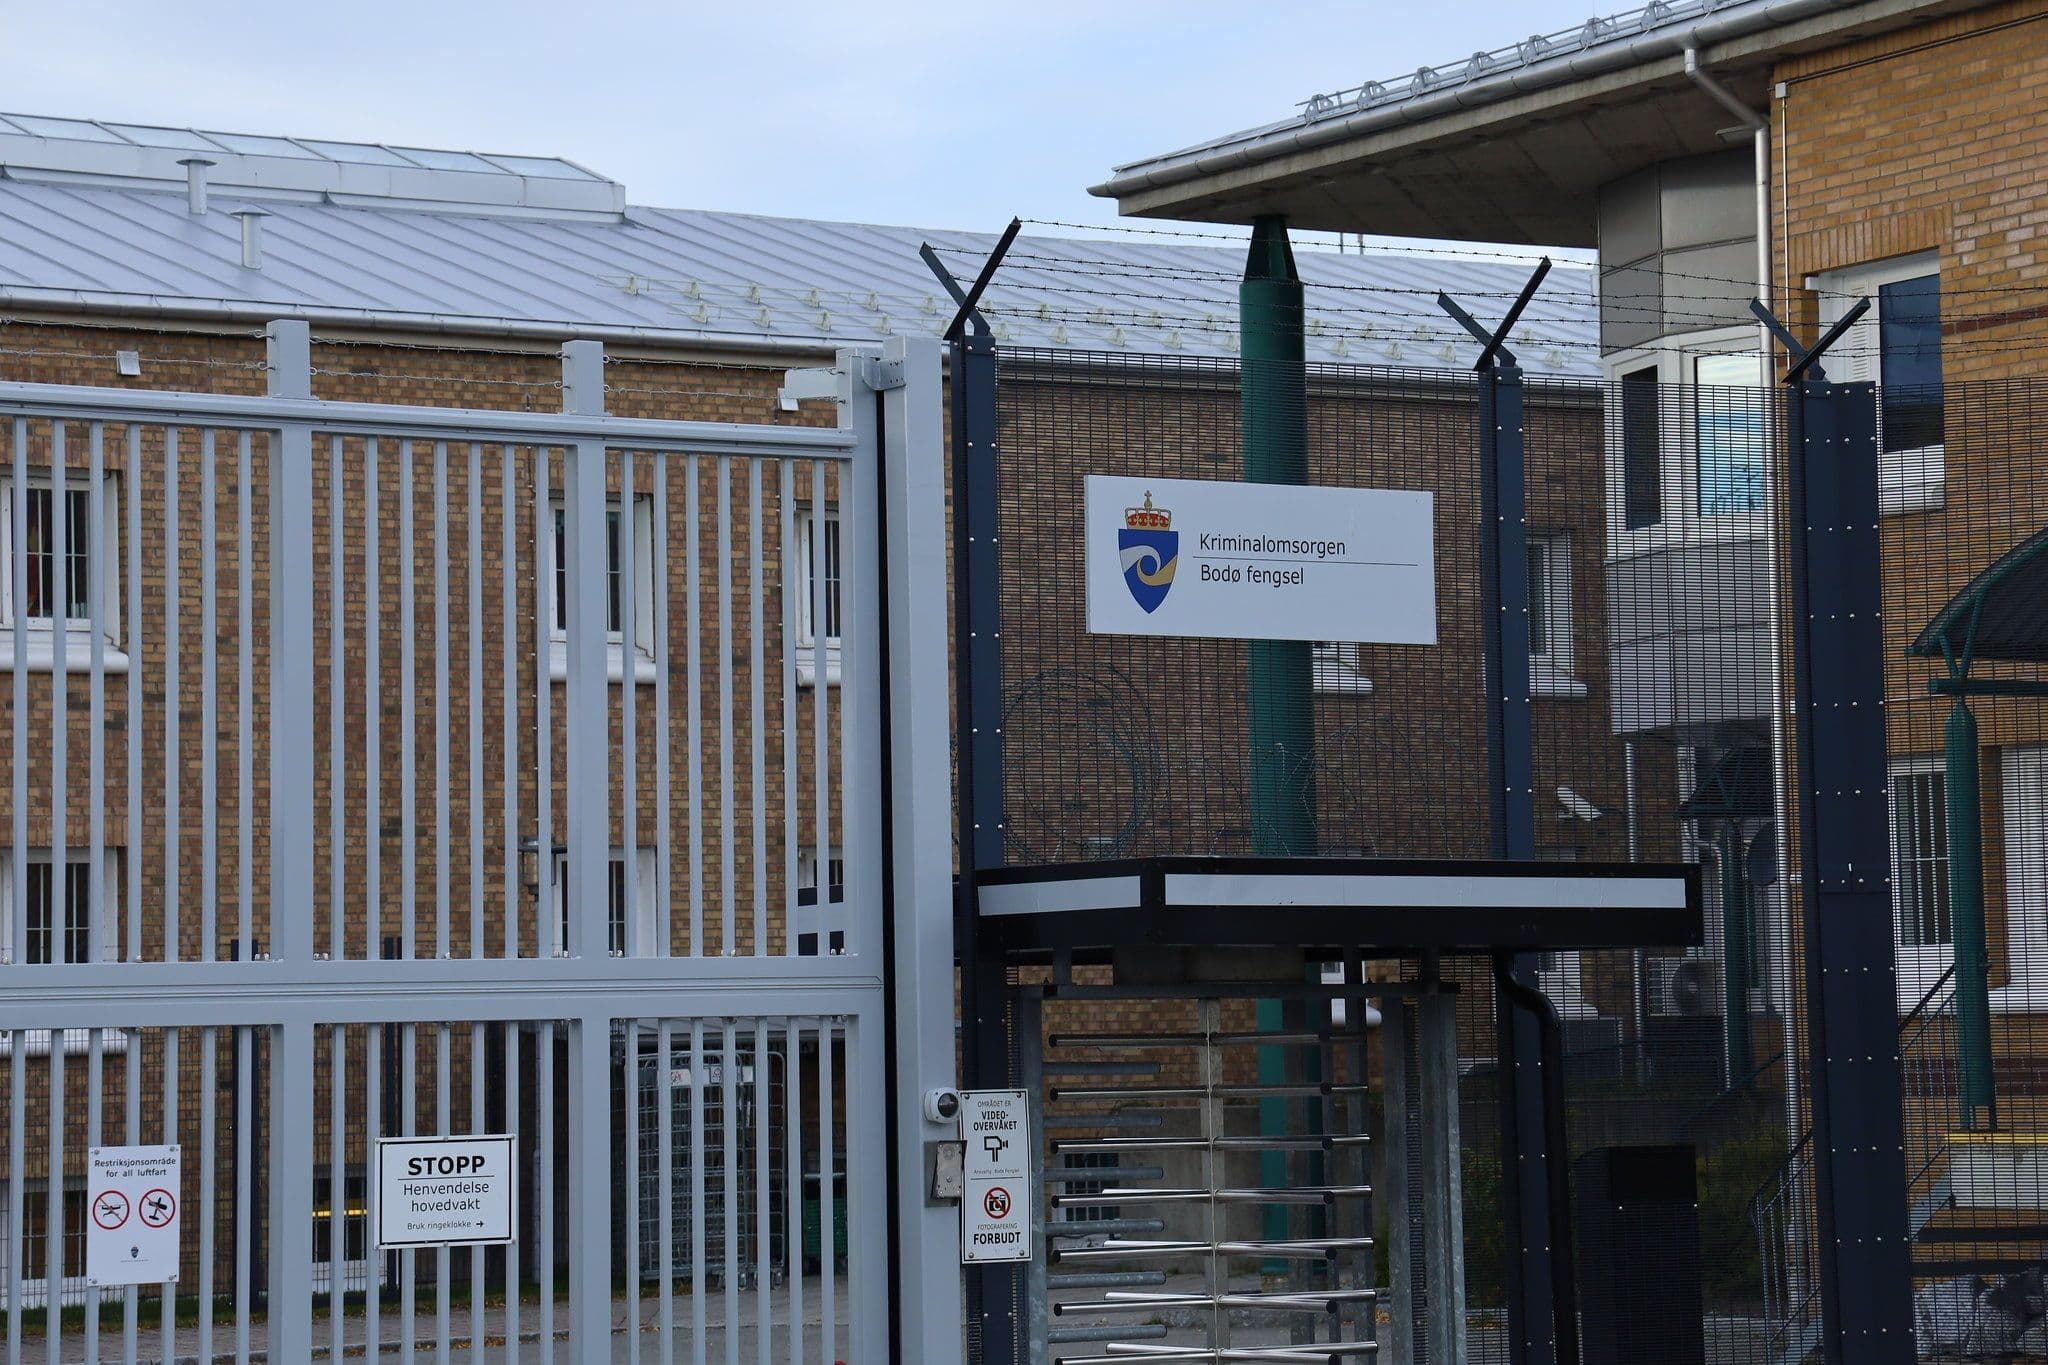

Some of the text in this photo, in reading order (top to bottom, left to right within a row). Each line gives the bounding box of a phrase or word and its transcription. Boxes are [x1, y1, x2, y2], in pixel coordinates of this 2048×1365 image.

[1200, 533, 1346, 558] Kriminalomsorgen
[1201, 564, 1304, 587] Bodø fengsel
[981, 1110, 1009, 1120] VIDEO-
[973, 1120, 1018, 1131] OVERVÅKET
[94, 1157, 176, 1168] Restriksjonsområde
[408, 1155, 485, 1175] STOPP
[122, 1169, 133, 1177] all
[138, 1168, 167, 1176] luftfart
[403, 1181, 489, 1196] Henvendelse
[411, 1198, 480, 1212] hovedvakt
[407, 1221, 471, 1231] Bruk ringeklokke
[973, 1232, 1021, 1245] FORBUDT
